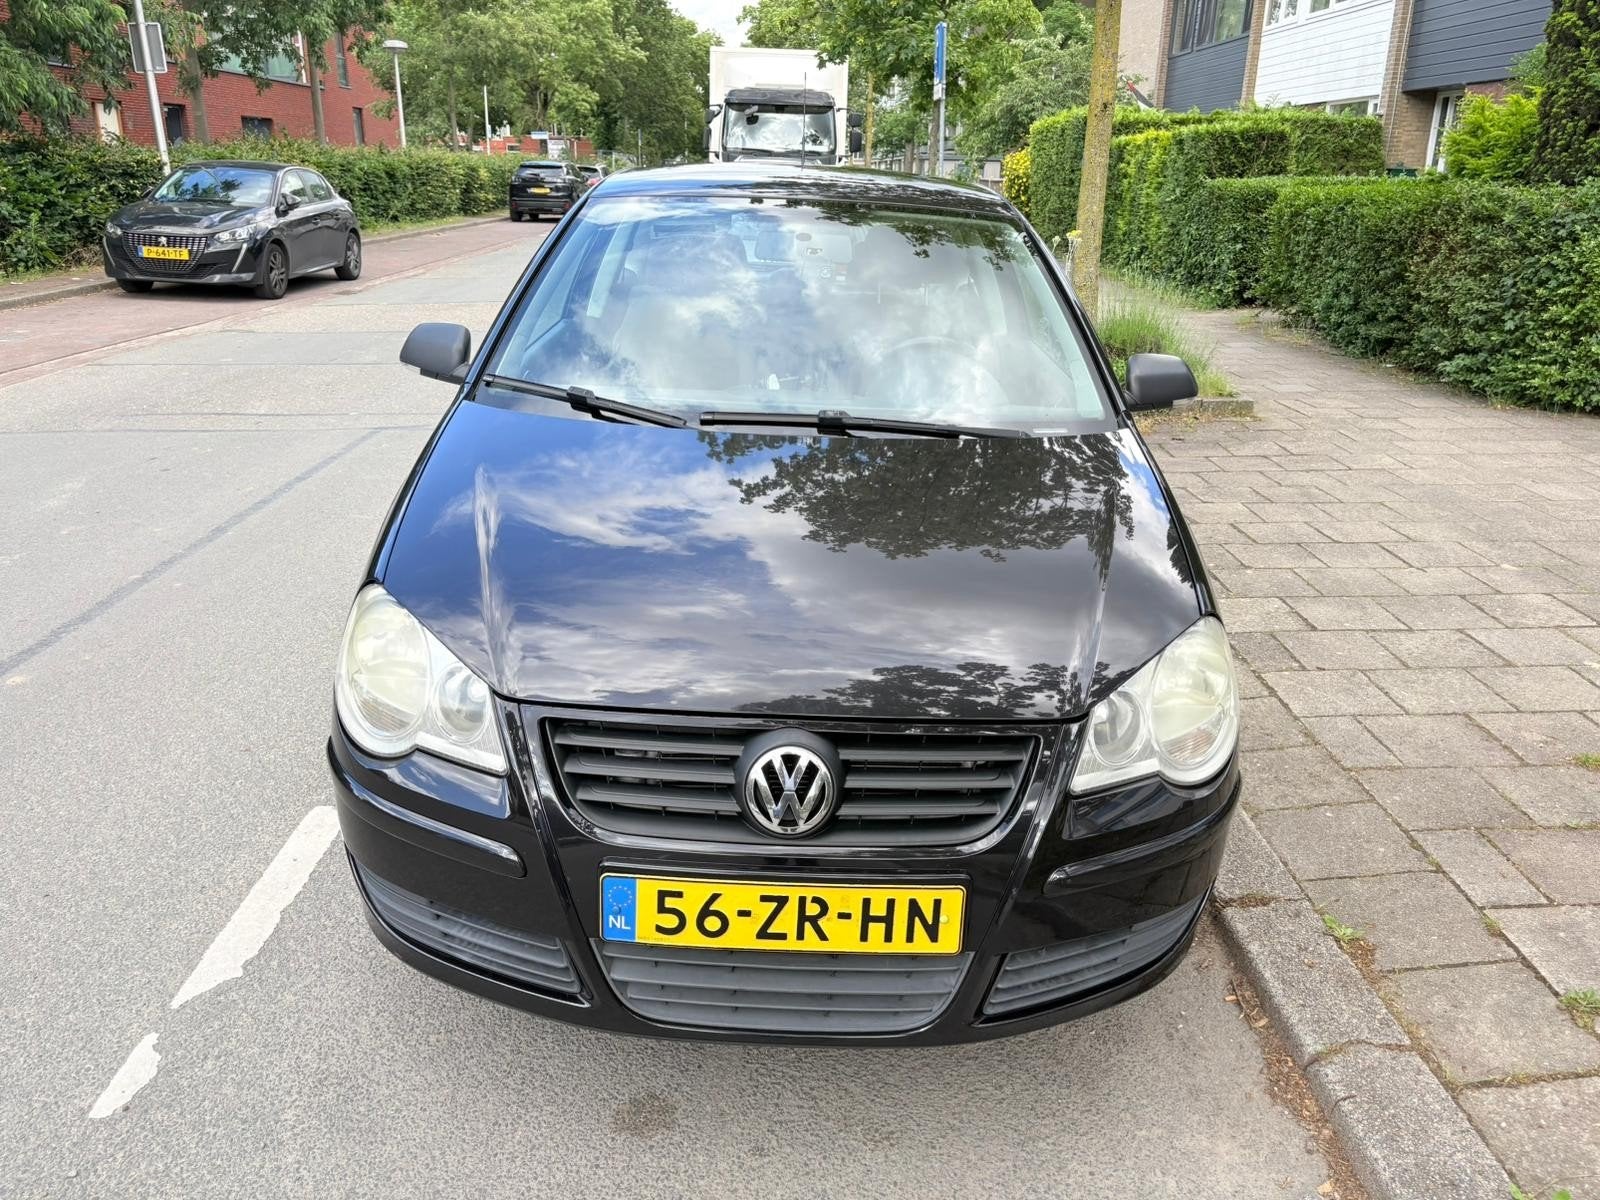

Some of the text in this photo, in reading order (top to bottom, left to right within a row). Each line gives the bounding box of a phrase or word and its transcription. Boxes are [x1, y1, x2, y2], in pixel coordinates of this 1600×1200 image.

[146, 248, 185, 258] P-641-TF
[608, 914, 632, 930] NL
[654, 889, 943, 944] 56-ZR-HN
